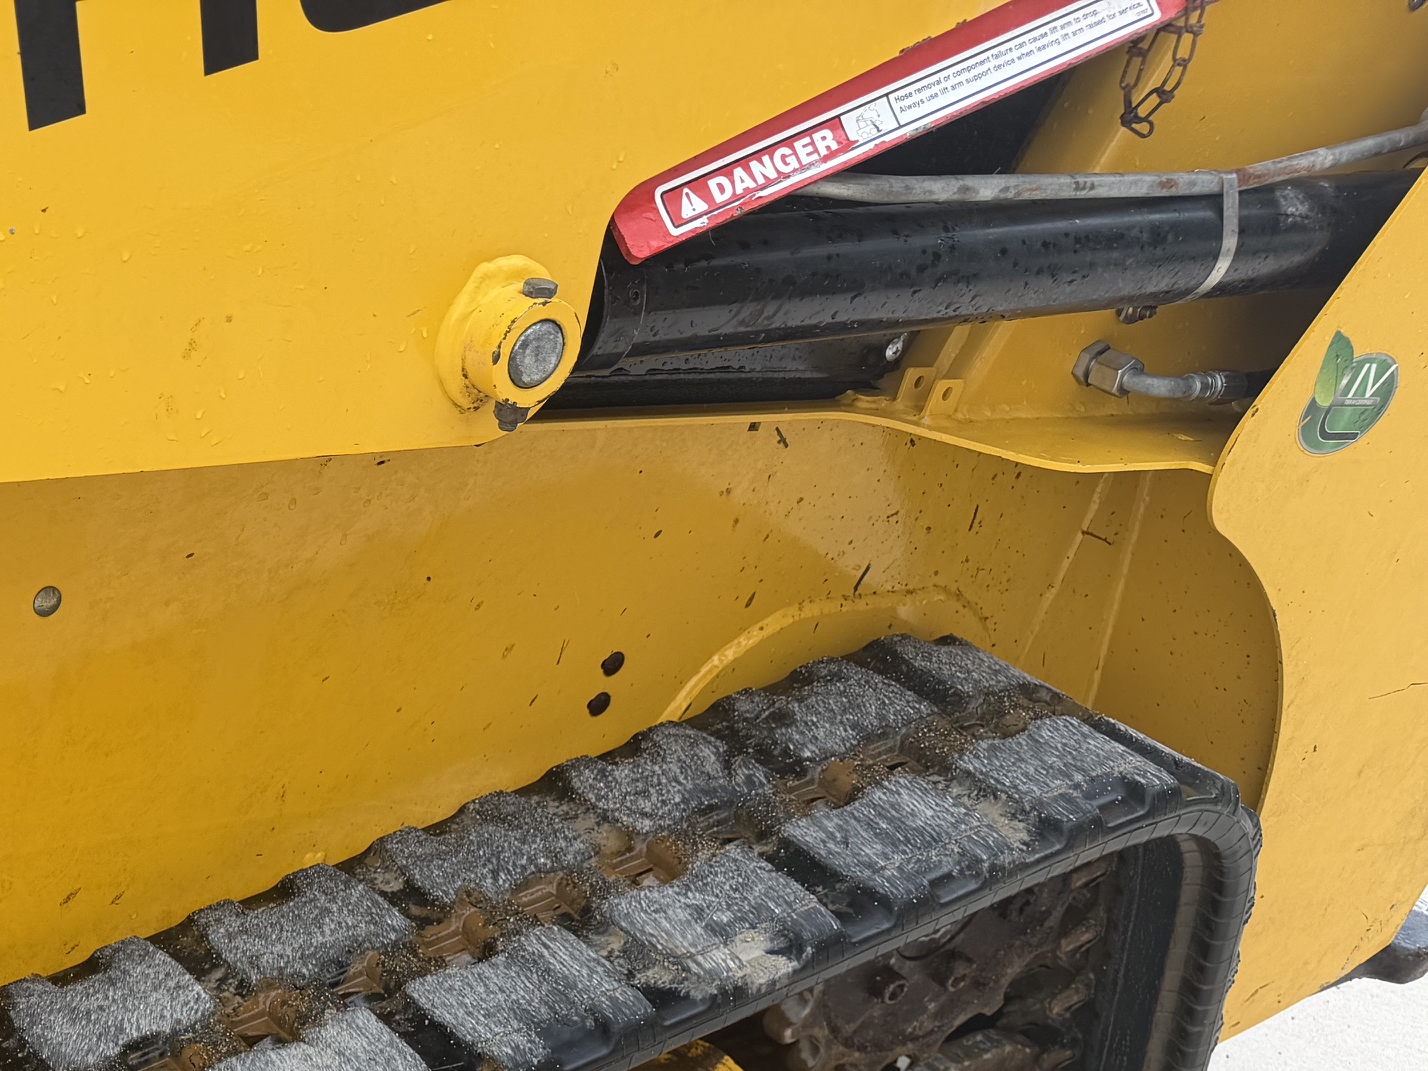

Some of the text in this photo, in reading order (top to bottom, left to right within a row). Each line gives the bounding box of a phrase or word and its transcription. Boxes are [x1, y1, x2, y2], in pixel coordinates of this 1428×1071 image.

[894, 91, 913, 104] Hose
[914, 77, 942, 96] removal
[943, 75, 951, 83] or
[952, 57, 991, 79] component
[991, 46, 1013, 61] failure
[1014, 40, 1027, 51] can
[1028, 31, 1049, 44] cause
[899, 98, 925, 114] Always
[926, 91, 939, 102] use
[939, 85, 950, 96] lift
[951, 80, 964, 90] arm
[965, 67, 993, 84] support
[993, 57, 1015, 72] device
[1016, 48, 1035, 61] when
[1035, 37, 1061, 53] leaving
[707, 128, 839, 203] DANGER
